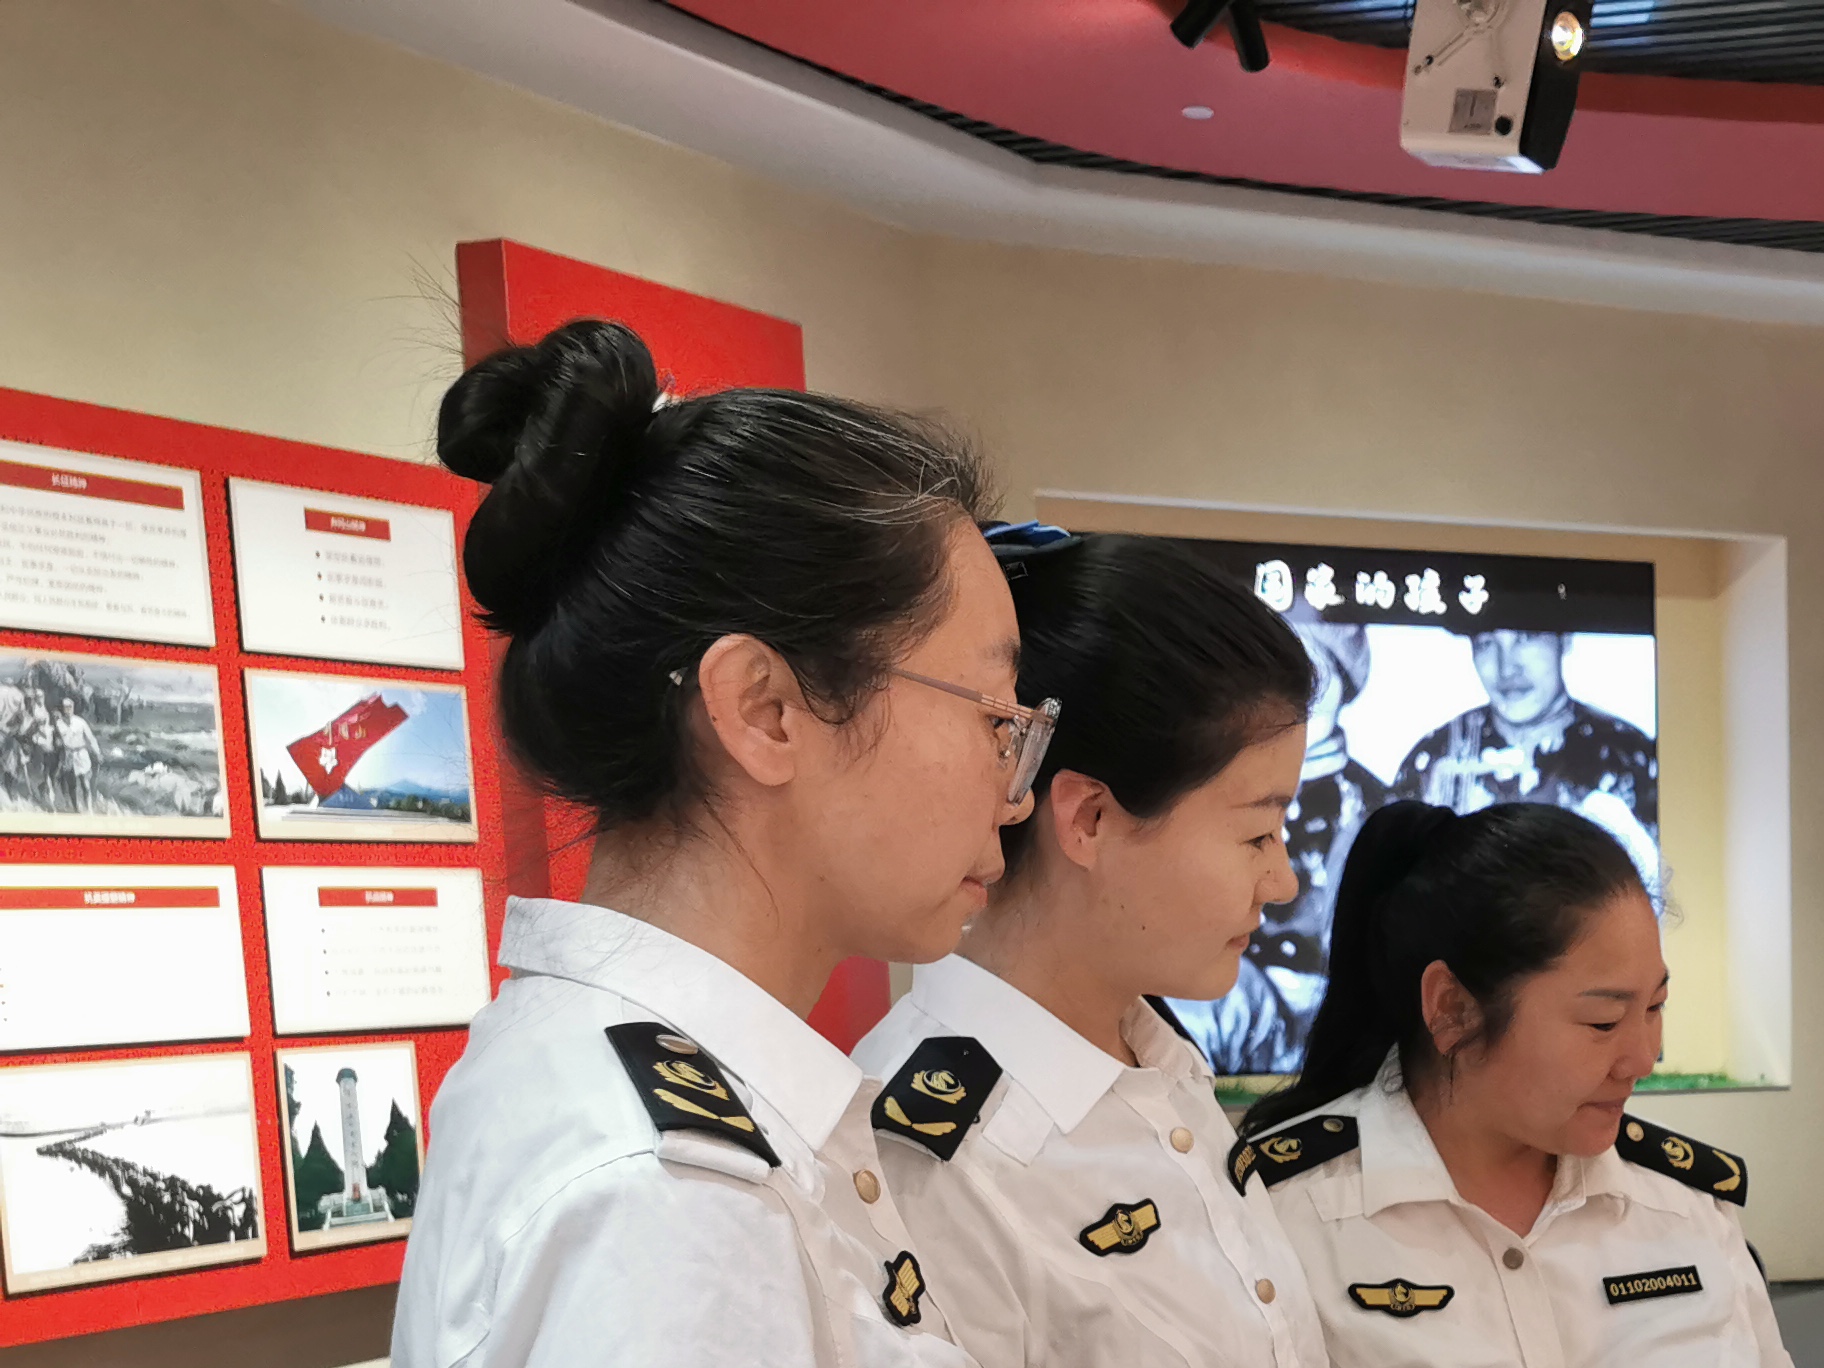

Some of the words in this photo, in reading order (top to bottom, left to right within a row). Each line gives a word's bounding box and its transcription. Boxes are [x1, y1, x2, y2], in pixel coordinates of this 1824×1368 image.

[1254, 559, 1490, 615] 国家的孩子
[1609, 1272, 1698, 1297] 01102004011
